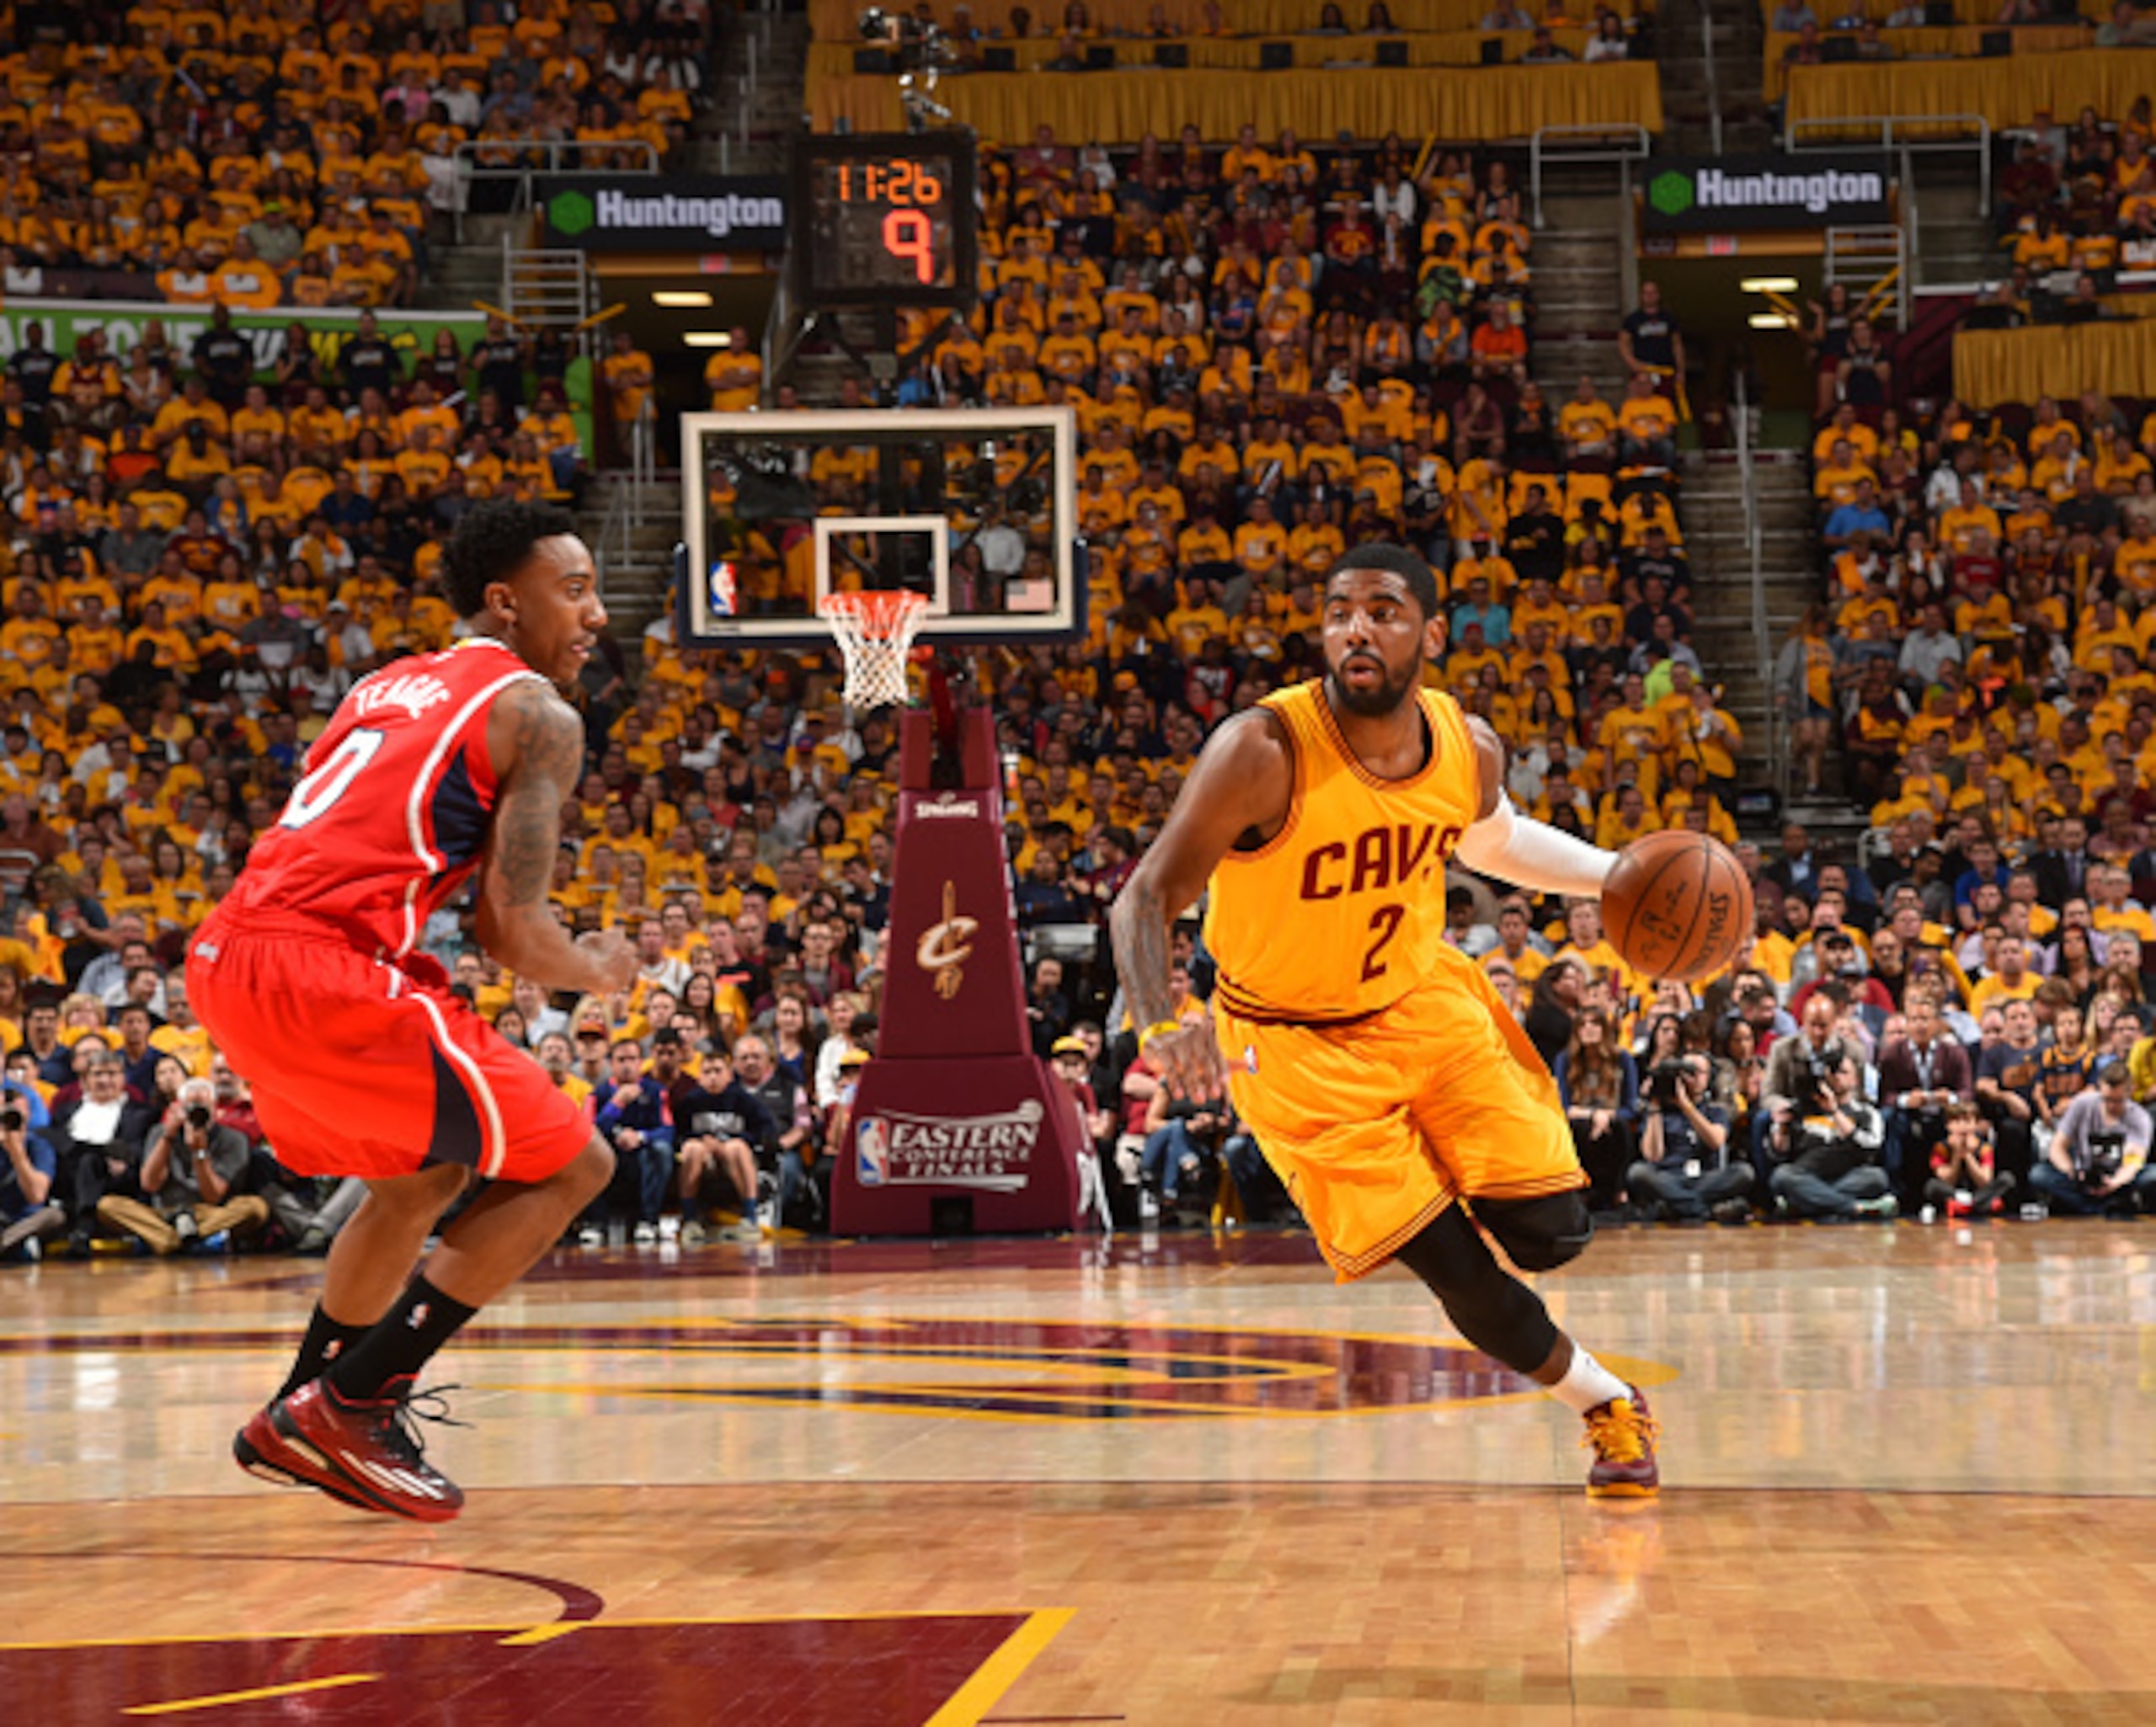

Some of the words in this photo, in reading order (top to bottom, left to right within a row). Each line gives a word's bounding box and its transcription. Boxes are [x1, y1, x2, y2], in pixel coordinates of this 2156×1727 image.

[840, 158, 942, 205] 11:26
[1696, 168, 1882, 213] Huntington
[595, 189, 783, 237] Huntington
[882, 209, 934, 285] 9
[279, 726, 386, 831] 0
[1359, 903, 1405, 983] 2
[891, 1123, 1039, 1149] EASTERN
[908, 1161, 1004, 1176] FINALS
